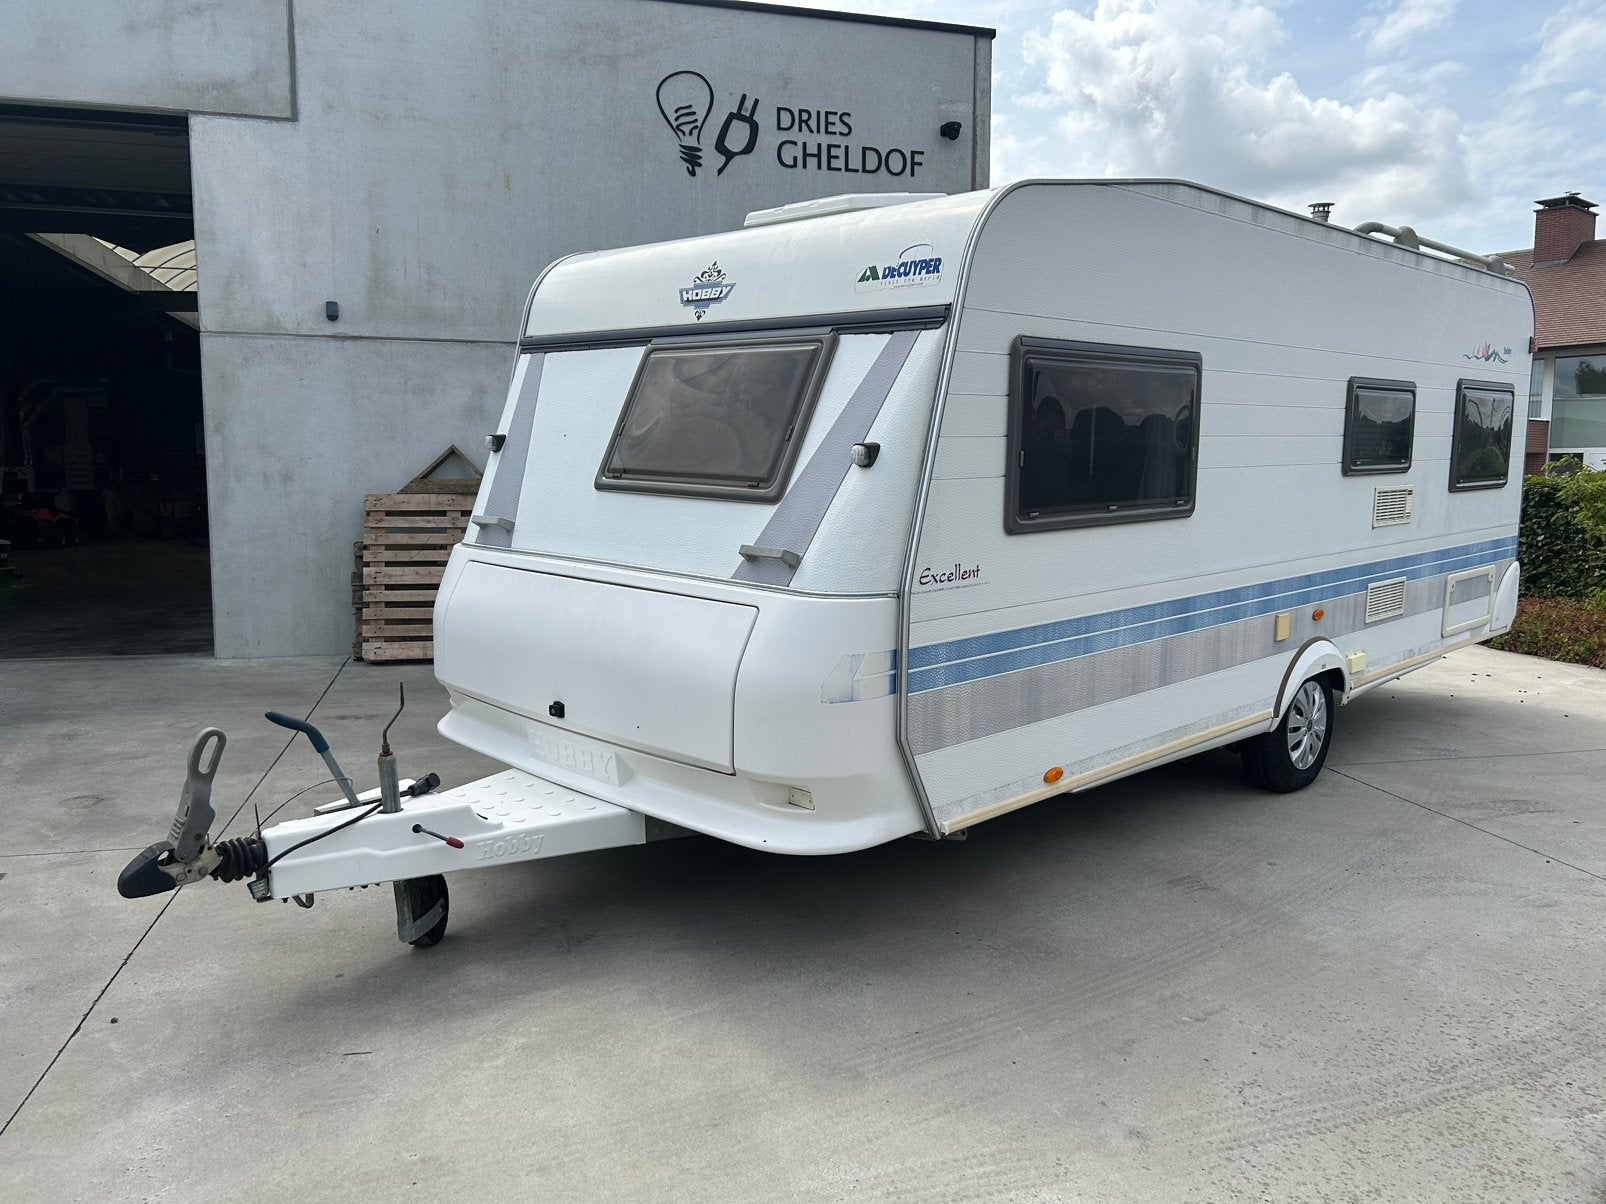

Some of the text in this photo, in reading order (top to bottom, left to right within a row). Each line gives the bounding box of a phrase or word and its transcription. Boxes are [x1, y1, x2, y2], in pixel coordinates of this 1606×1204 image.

[776, 106, 853, 137] DRIES
[776, 139, 925, 177] GHELDOF
[682, 286, 731, 301] HOBBY
[919, 563, 981, 585] Excellent
